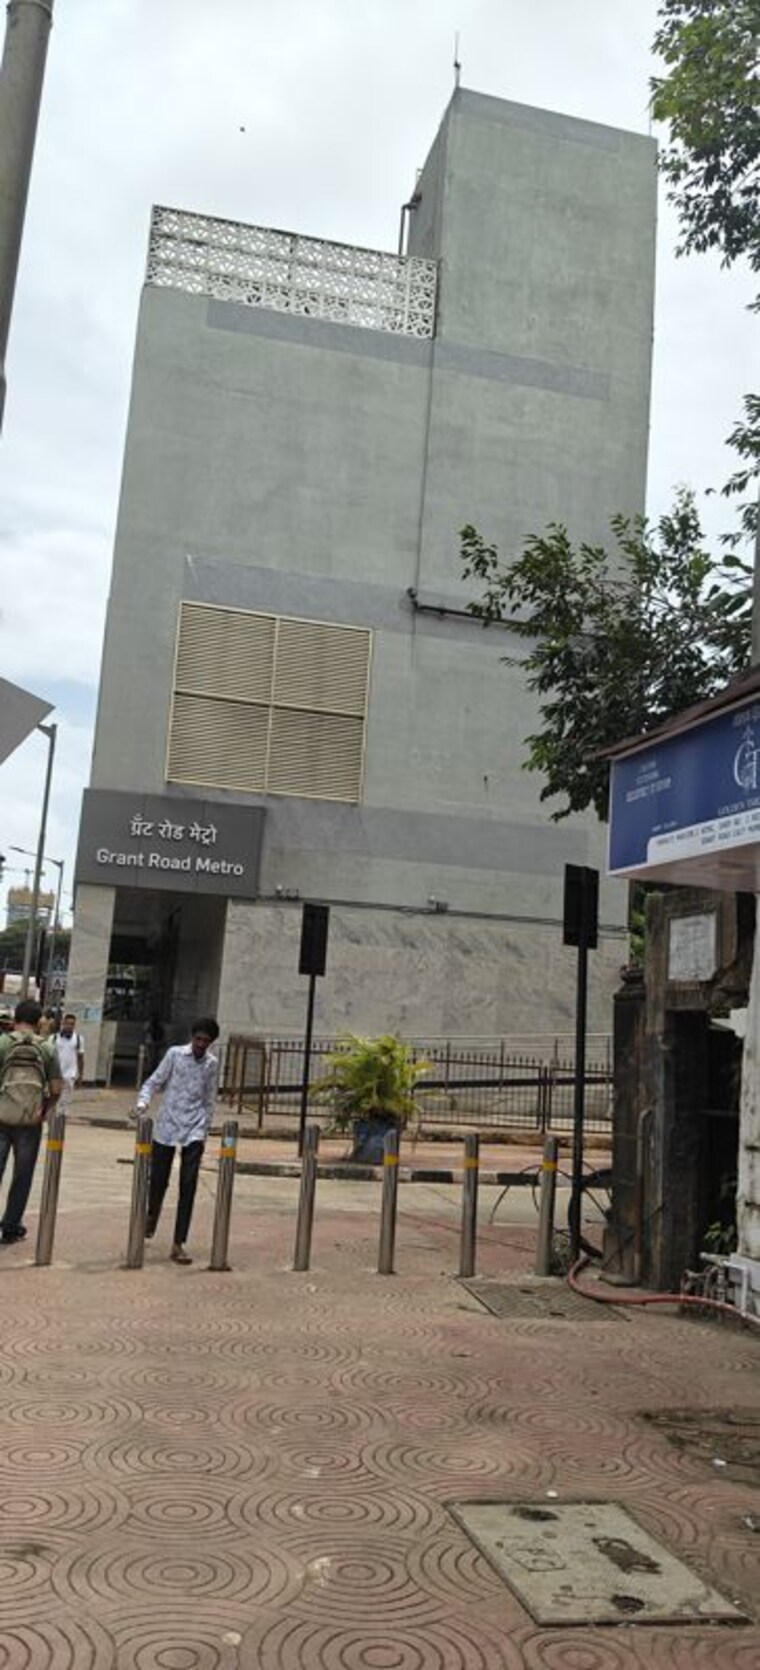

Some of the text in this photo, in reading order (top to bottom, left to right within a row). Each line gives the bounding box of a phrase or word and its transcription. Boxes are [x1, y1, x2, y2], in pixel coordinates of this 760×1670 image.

[158, 819, 185, 840] रोड
[189, 822, 218, 844] मेट्रो
[96, 848, 244, 875] Grant Road Metro
